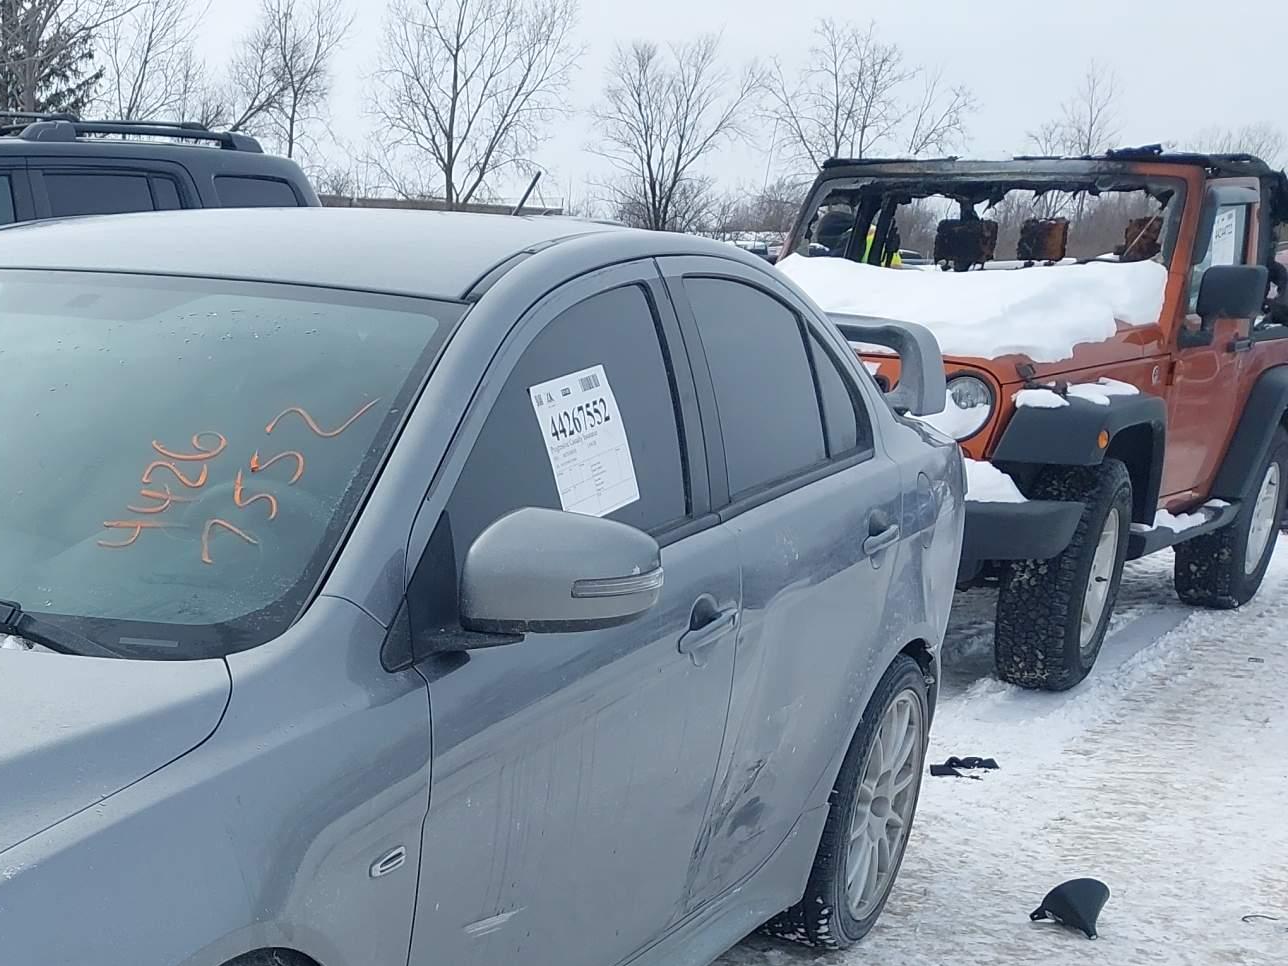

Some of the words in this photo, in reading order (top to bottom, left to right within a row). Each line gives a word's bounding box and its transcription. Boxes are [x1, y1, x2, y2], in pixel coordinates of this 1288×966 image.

[550, 397, 611, 441] 44267552
[97, 430, 227, 547] 4426
[201, 397, 382, 564] 7552
